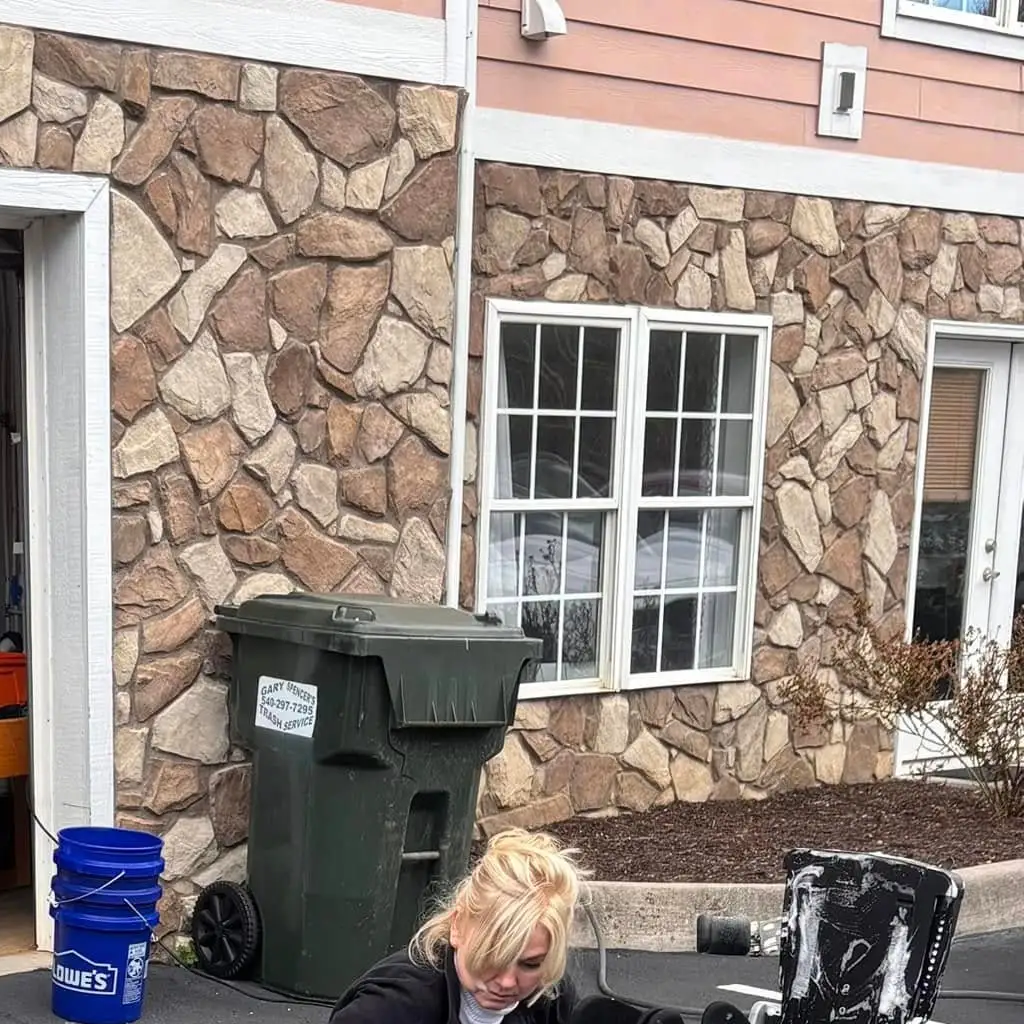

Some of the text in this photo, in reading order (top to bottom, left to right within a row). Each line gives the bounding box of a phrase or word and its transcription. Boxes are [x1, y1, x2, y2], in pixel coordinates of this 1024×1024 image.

[261, 681, 316, 705] GARY SPENCER'S
[259, 704, 314, 731] TRASH SERVICE
